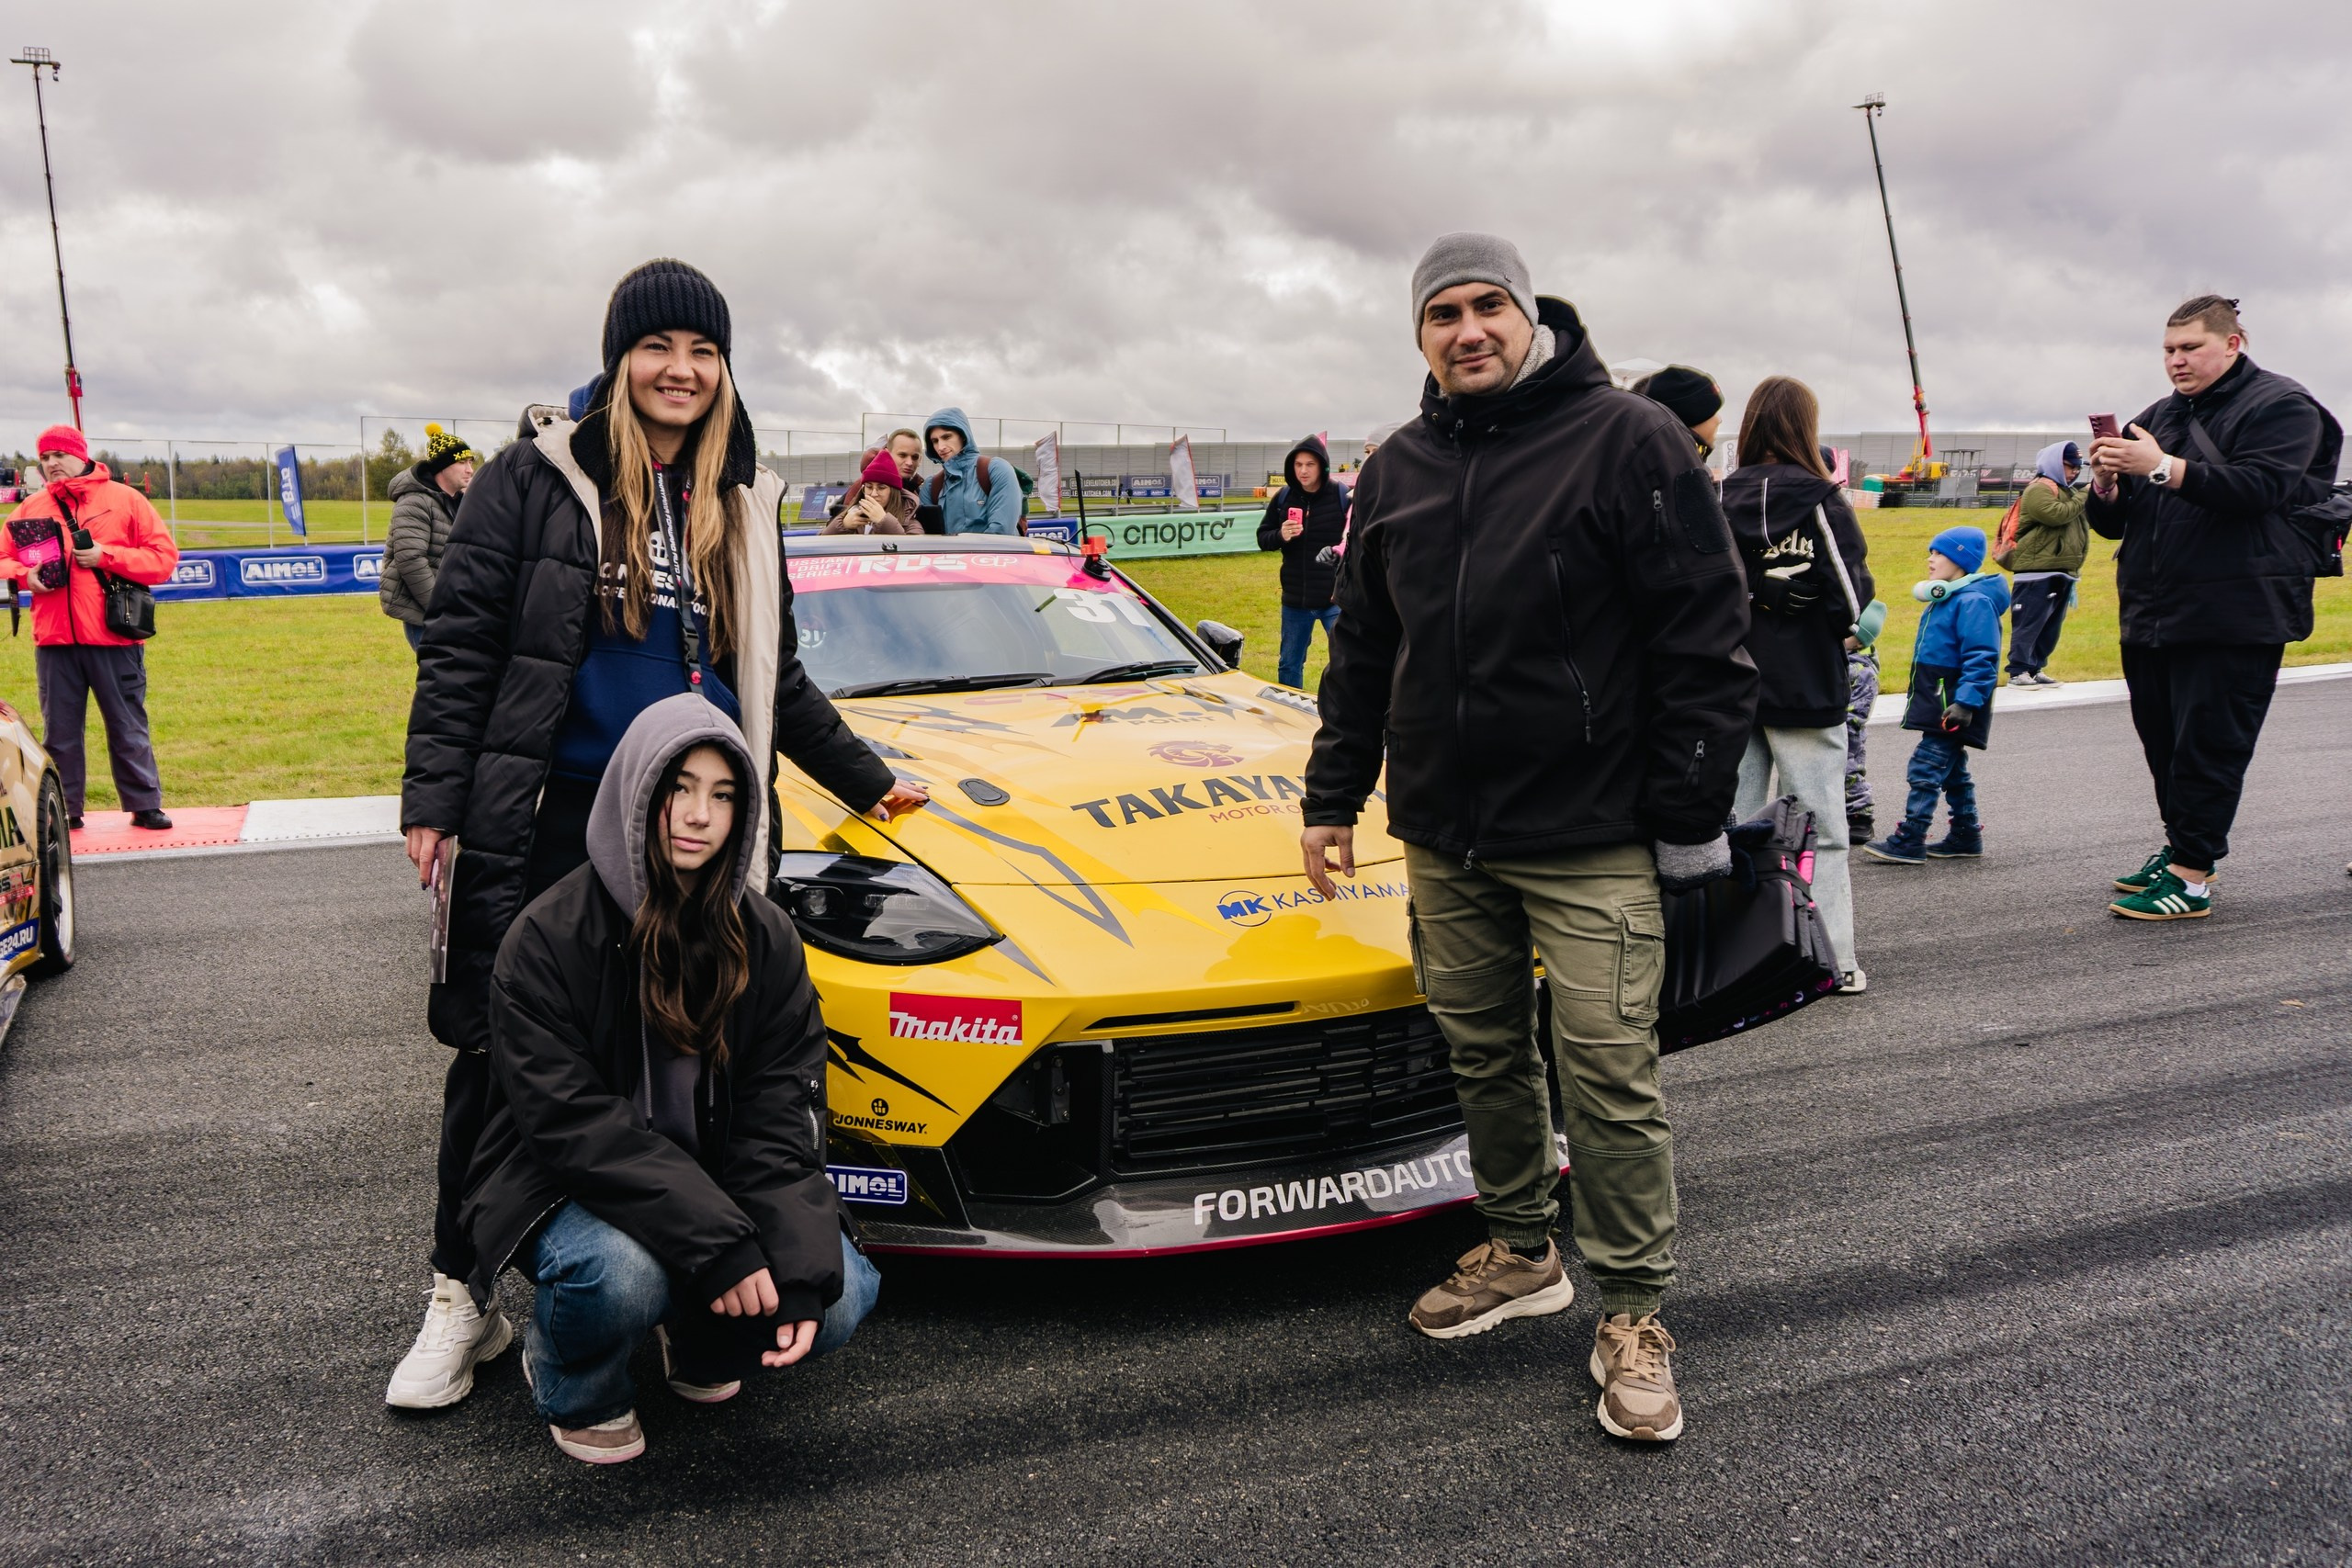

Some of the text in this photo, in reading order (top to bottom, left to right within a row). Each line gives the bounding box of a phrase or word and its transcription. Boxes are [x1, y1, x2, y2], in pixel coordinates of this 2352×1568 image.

[657, 472, 681, 574] TAKAYAMA FORWARD AUTO
[245, 561, 321, 580] AIMOL
[787, 558, 846, 567] USSIAN
[797, 563, 842, 572] DRIFT
[858, 554, 967, 574] RDS
[788, 569, 842, 581] SERIES
[1053, 588, 1152, 627] 31
[1128, 716, 1216, 726] POINT
[1208, 803, 1280, 824] MOTOR
[1216, 896, 1273, 920] MK
[834, 1113, 928, 1134] JONNESWAY
